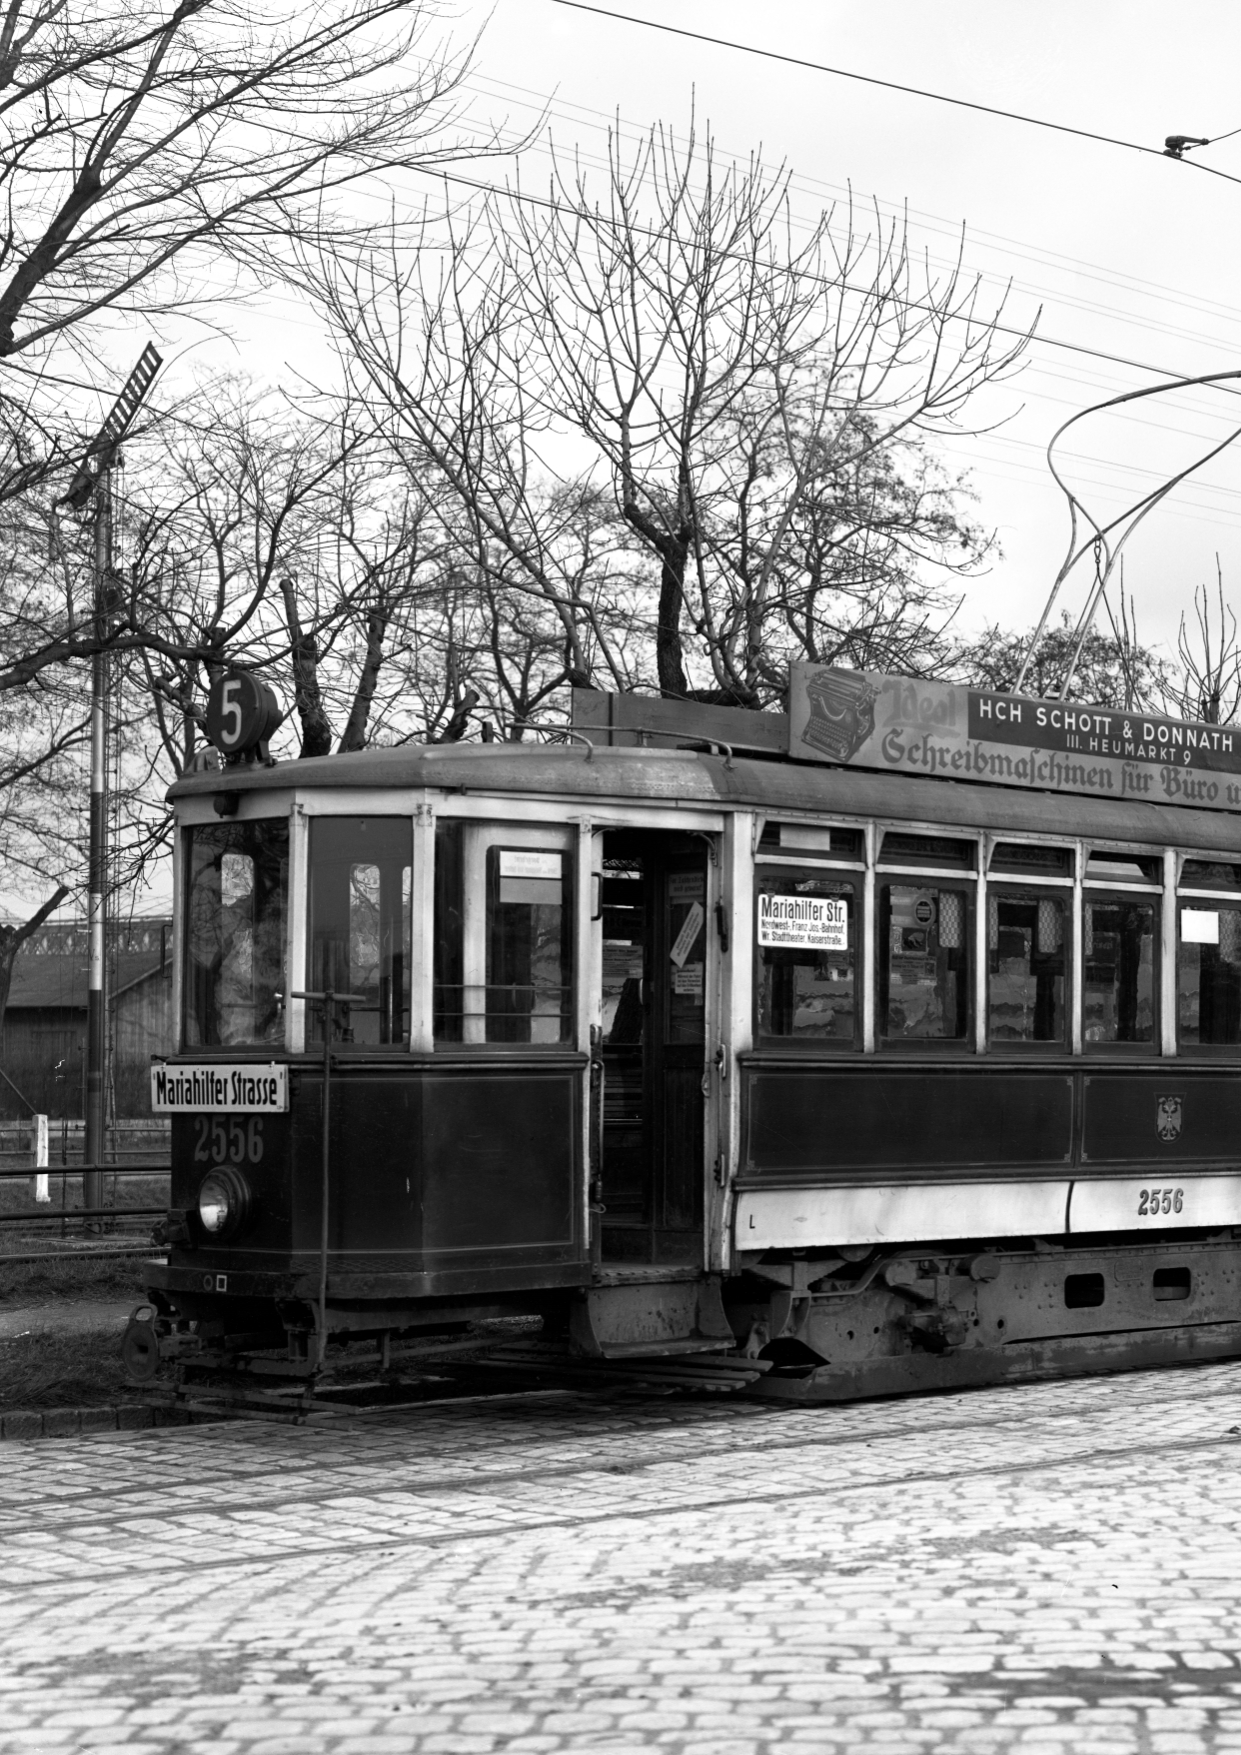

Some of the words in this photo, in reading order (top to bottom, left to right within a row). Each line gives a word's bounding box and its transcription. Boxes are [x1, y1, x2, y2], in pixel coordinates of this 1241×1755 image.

[221, 679, 242, 745] 5
[882, 680, 956, 729] Ideal
[979, 698, 1022, 723] HCH
[1036, 707, 1112, 735] SCHOTT
[1122, 720, 1133, 739] &
[1143, 719, 1233, 752] DONNATH
[1066, 734, 1083, 749] III.
[1089, 737, 1176, 761] HEUMARKT
[1183, 750, 1191, 765] 9
[1121, 761, 1154, 795] für
[1160, 765, 1219, 802] Büro
[761, 897, 824, 921] Mariahilfer
[827, 902, 845, 923] Str.
[156, 1071, 228, 1105] Mariahilfer
[231, 1071, 277, 1105] Strasse
[194, 1115, 264, 1163] 2556
[1138, 1187, 1184, 1216] 2556
[749, 1214, 756, 1229] L
